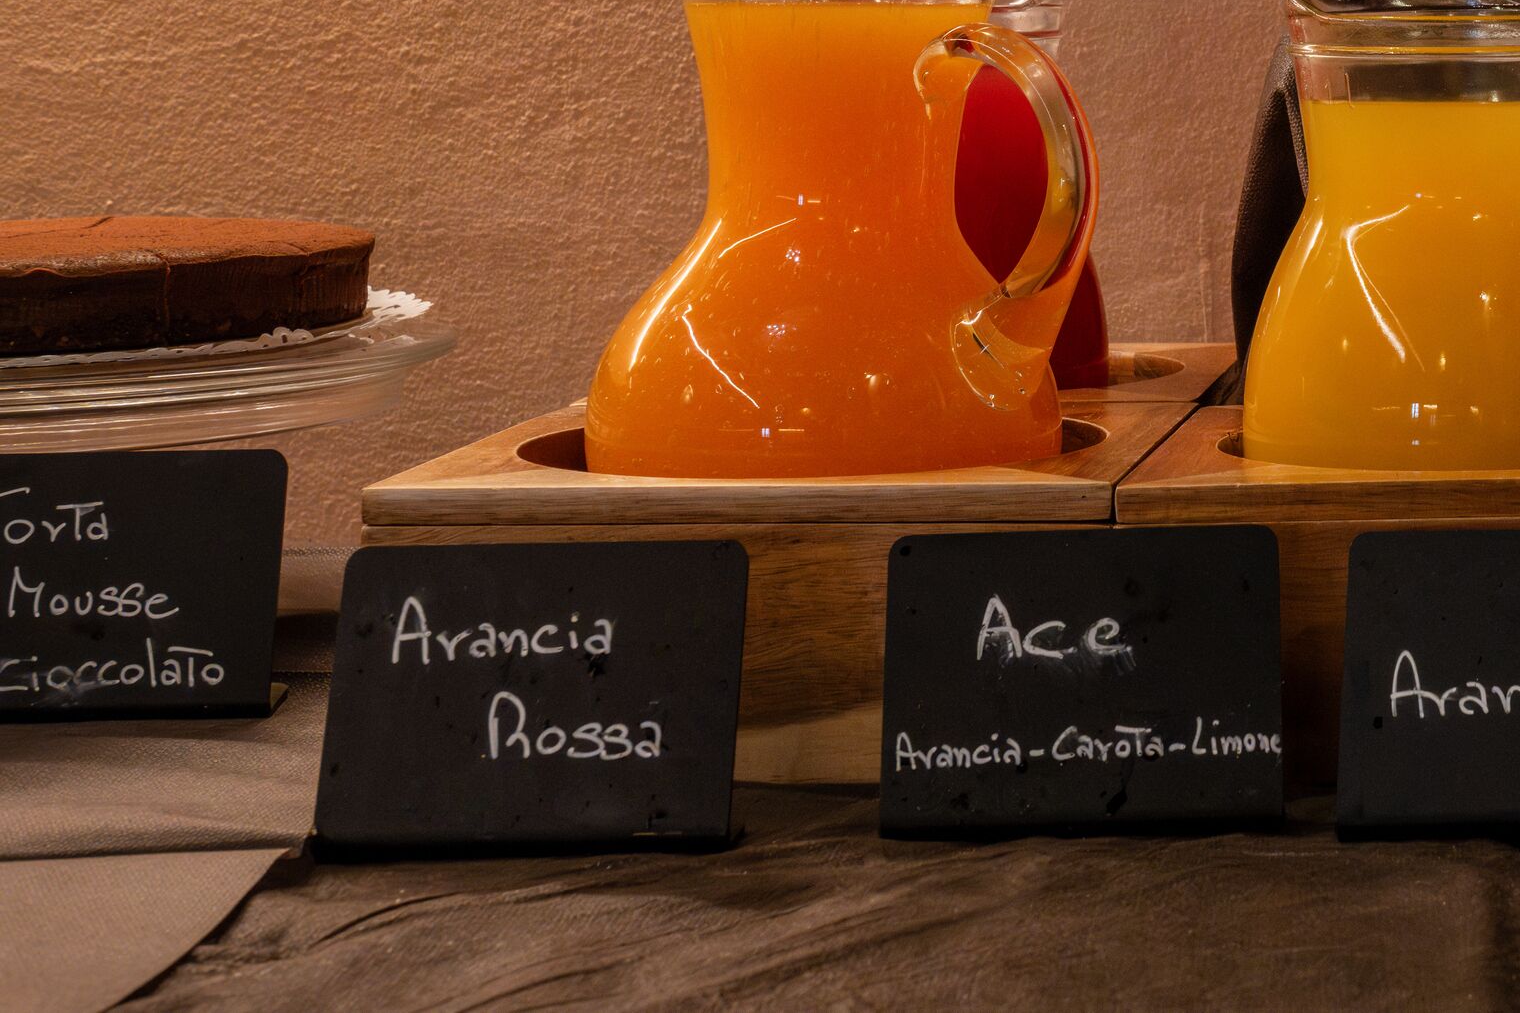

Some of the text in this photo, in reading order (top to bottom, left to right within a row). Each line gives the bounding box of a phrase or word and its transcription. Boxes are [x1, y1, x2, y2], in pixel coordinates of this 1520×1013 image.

[0, 487, 108, 545] orta
[8, 566, 180, 619] Mousse
[392, 596, 613, 665] Arancia
[977, 594, 1130, 662] Ace
[488, 691, 661, 760] Rossa
